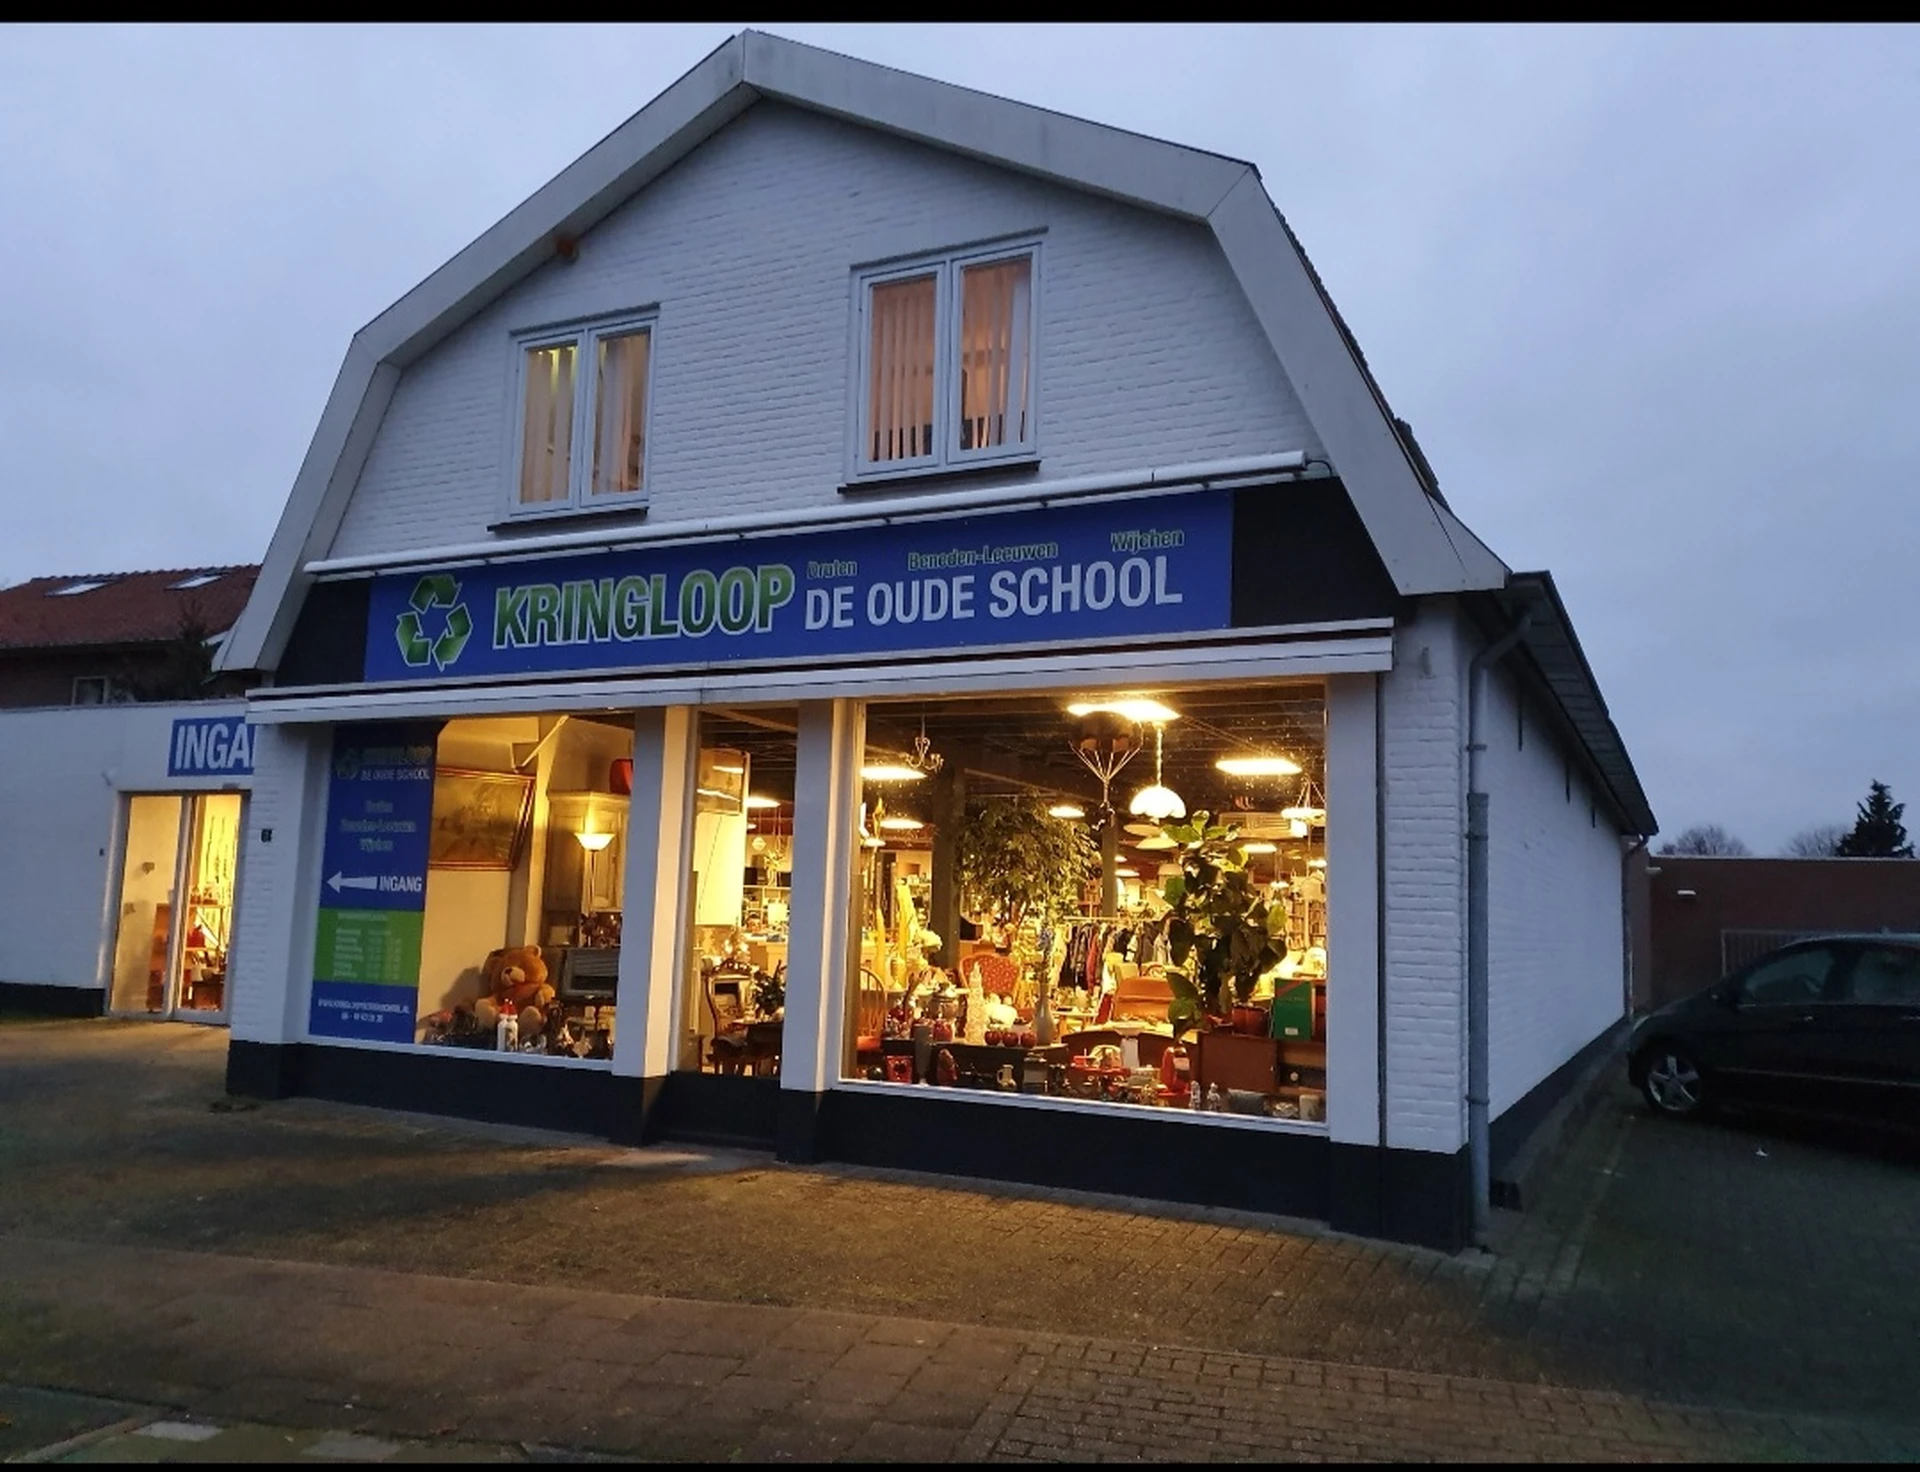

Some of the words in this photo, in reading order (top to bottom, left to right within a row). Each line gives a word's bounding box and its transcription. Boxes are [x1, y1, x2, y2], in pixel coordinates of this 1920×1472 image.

[908, 541, 1058, 571] Beneden-Leeuwen
[1110, 528, 1184, 554] Wijchen
[493, 564, 796, 650] KRINGLOOP
[805, 586, 854, 630] DE
[866, 575, 975, 624] OUDE
[989, 556, 1183, 618] SCHOOL
[174, 722, 257, 770] INGA
[379, 876, 422, 892] INGANG
